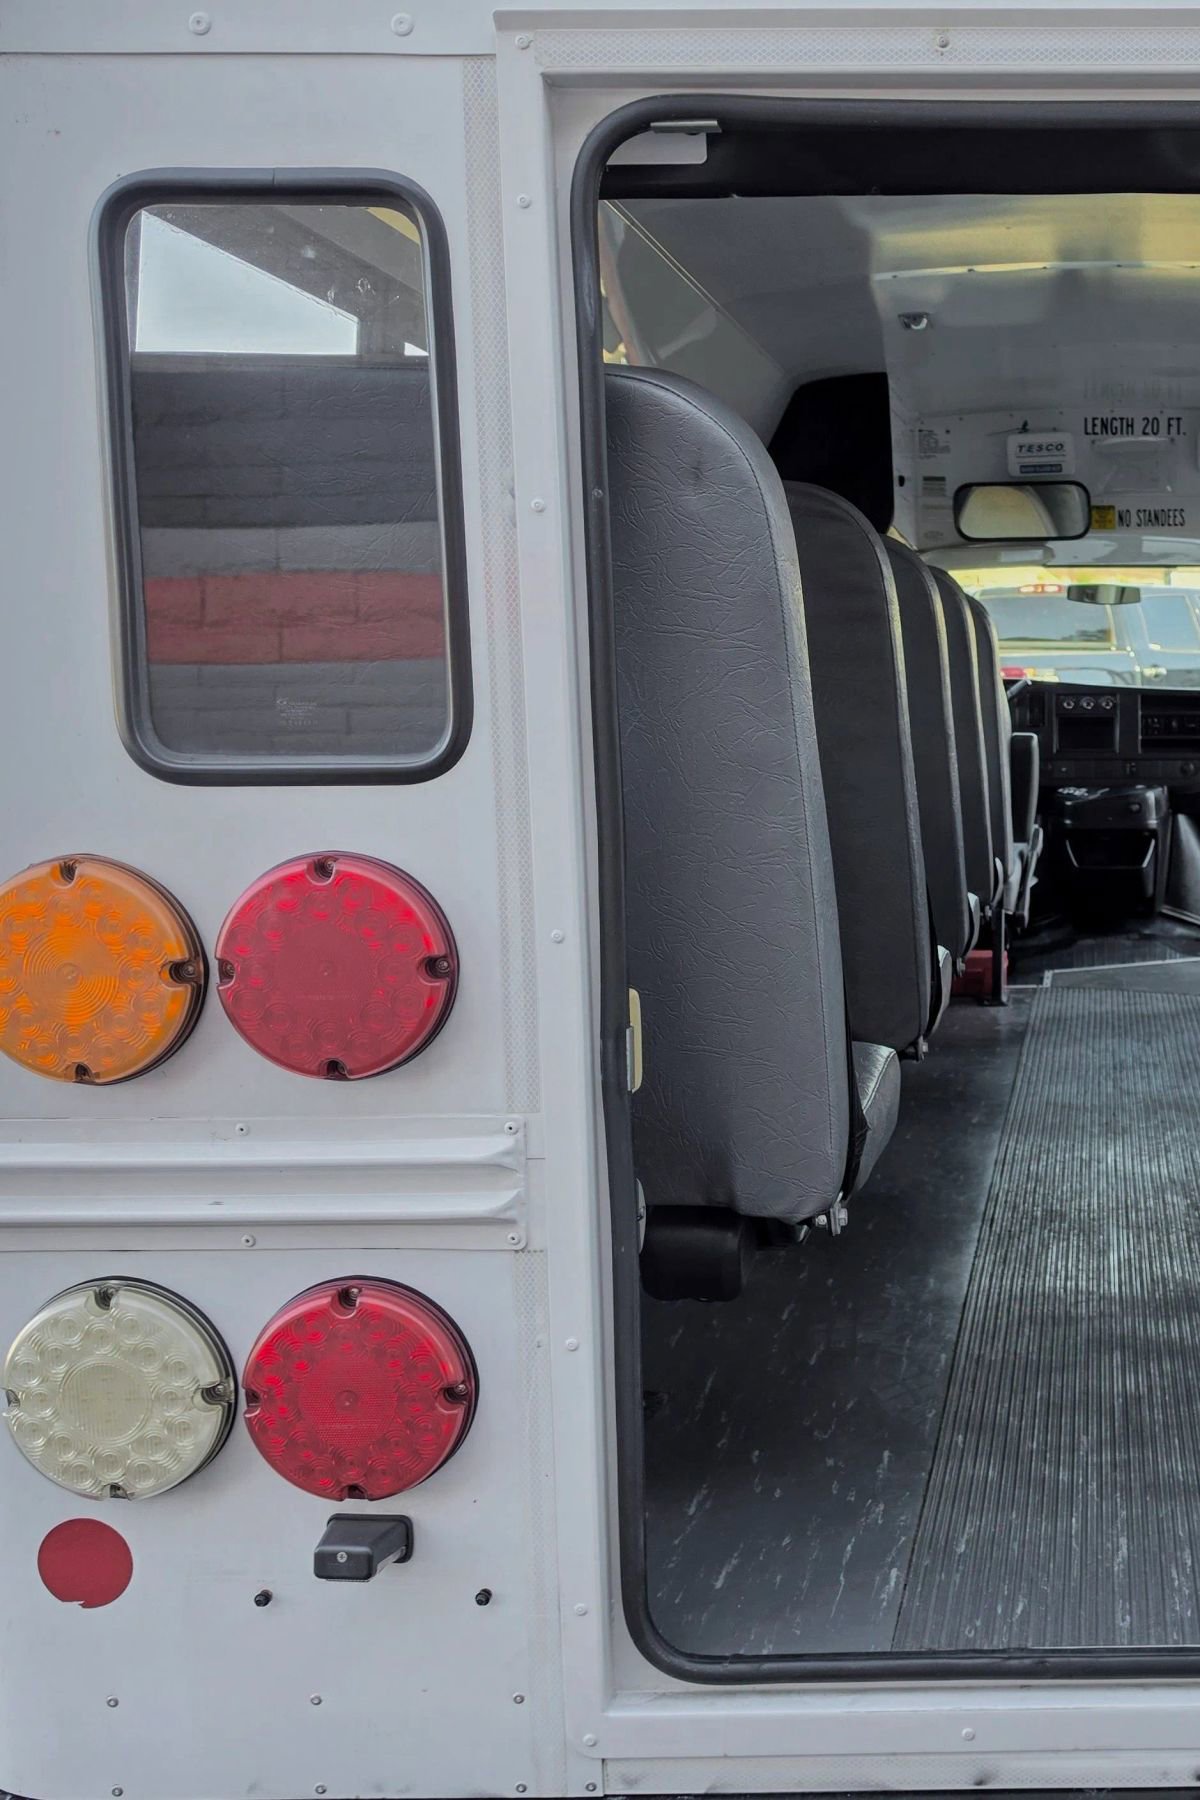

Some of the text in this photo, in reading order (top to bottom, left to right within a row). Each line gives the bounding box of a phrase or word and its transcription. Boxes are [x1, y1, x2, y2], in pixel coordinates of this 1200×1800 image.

[1084, 417, 1187, 436] LENGTH 20 FT.
[1018, 443, 1065, 453] TESCO
[1118, 509, 1131, 527] NO
[1136, 508, 1185, 527] STANDEES
